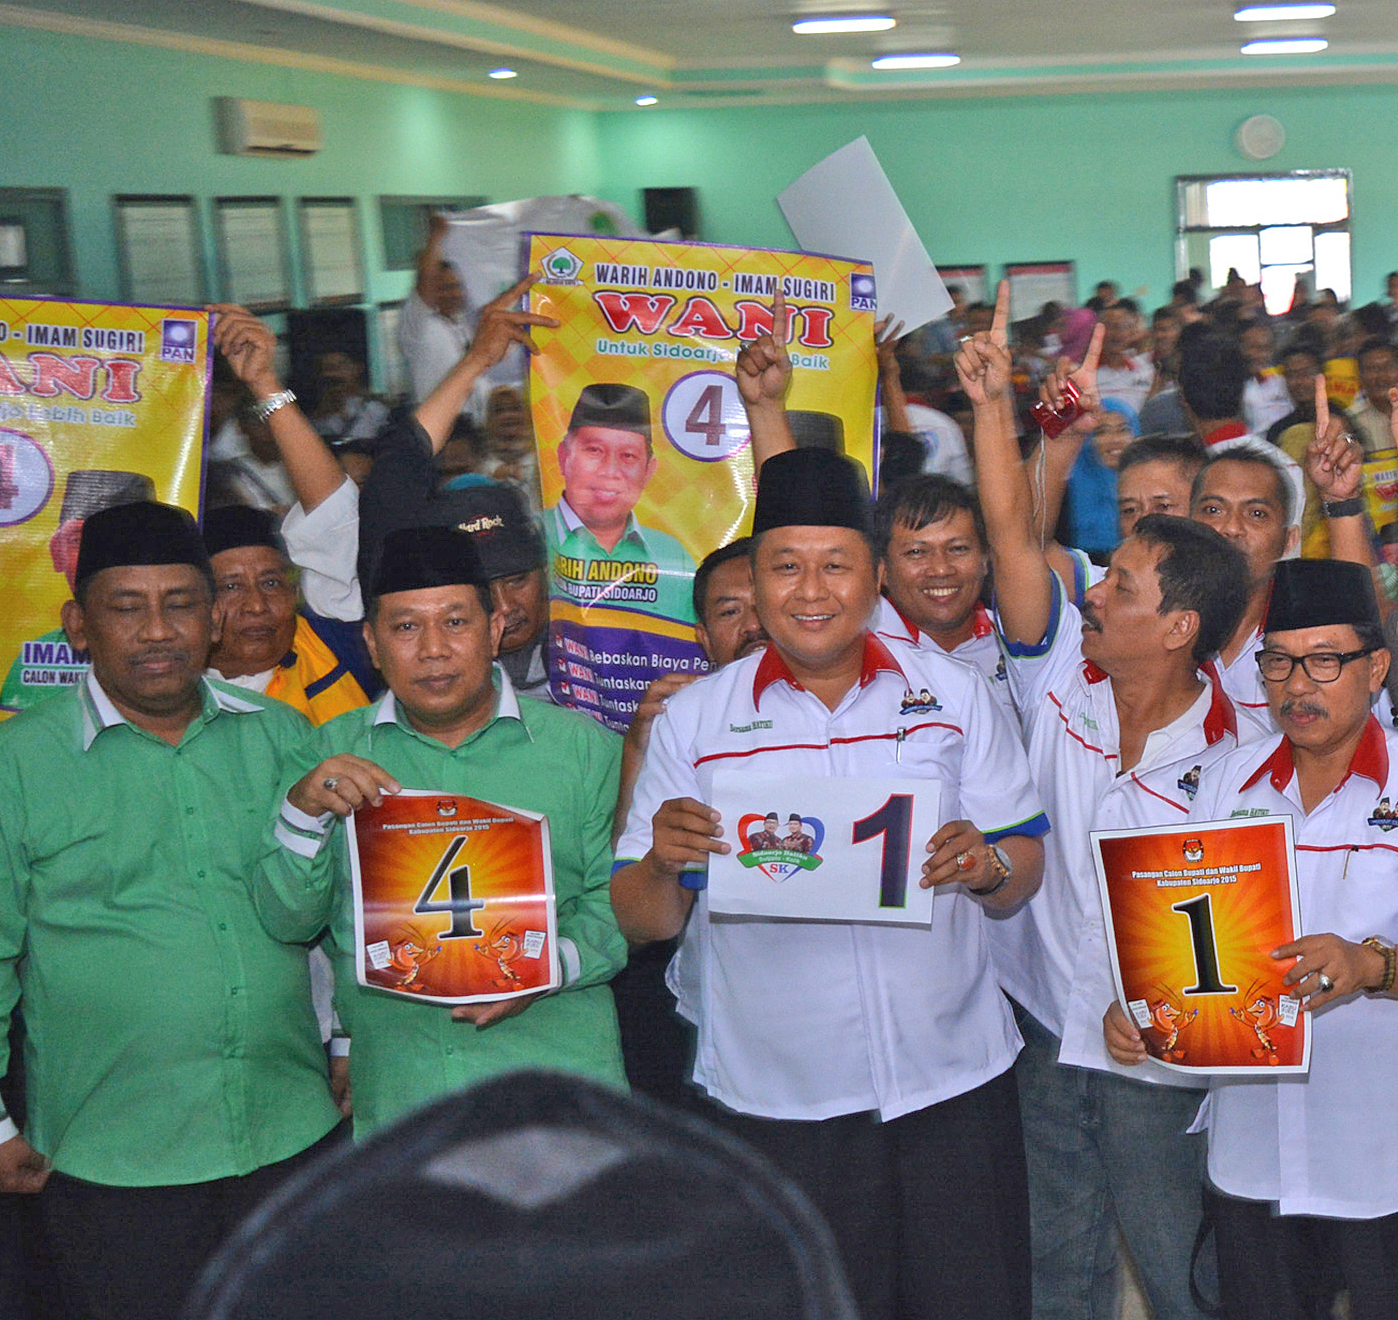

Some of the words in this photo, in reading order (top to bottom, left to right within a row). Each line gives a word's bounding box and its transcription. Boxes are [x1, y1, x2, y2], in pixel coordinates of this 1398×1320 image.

[596, 264, 647, 286] WARIH
[653, 268, 717, 291] ANDONO
[734, 274, 778, 295] IMAM
[783, 277, 836, 301] SUGIRI
[851, 297, 877, 309] PAN
[594, 292, 833, 347] WANI
[27, 325, 76, 347] IMAM
[83, 329, 143, 352] SUGIRI
[163, 348, 194, 361] PAN
[597, 340, 647, 356] Untuk
[791, 353, 829, 369] Baik
[685, 384, 727, 446] 4
[587, 559, 658, 585] ANDONO
[603, 586, 657, 602] SIDOARJO
[651, 653, 689, 671] Biaya
[23, 670, 57, 684] CALON
[852, 793, 914, 909] 1
[770, 863, 789, 873] SK
[1132, 871, 1163, 879] Pasangan
[1205, 867, 1218, 875] dan
[1221, 875, 1237, 883] 2015
[413, 835, 485, 939] 4
[1172, 892, 1238, 996] 1
